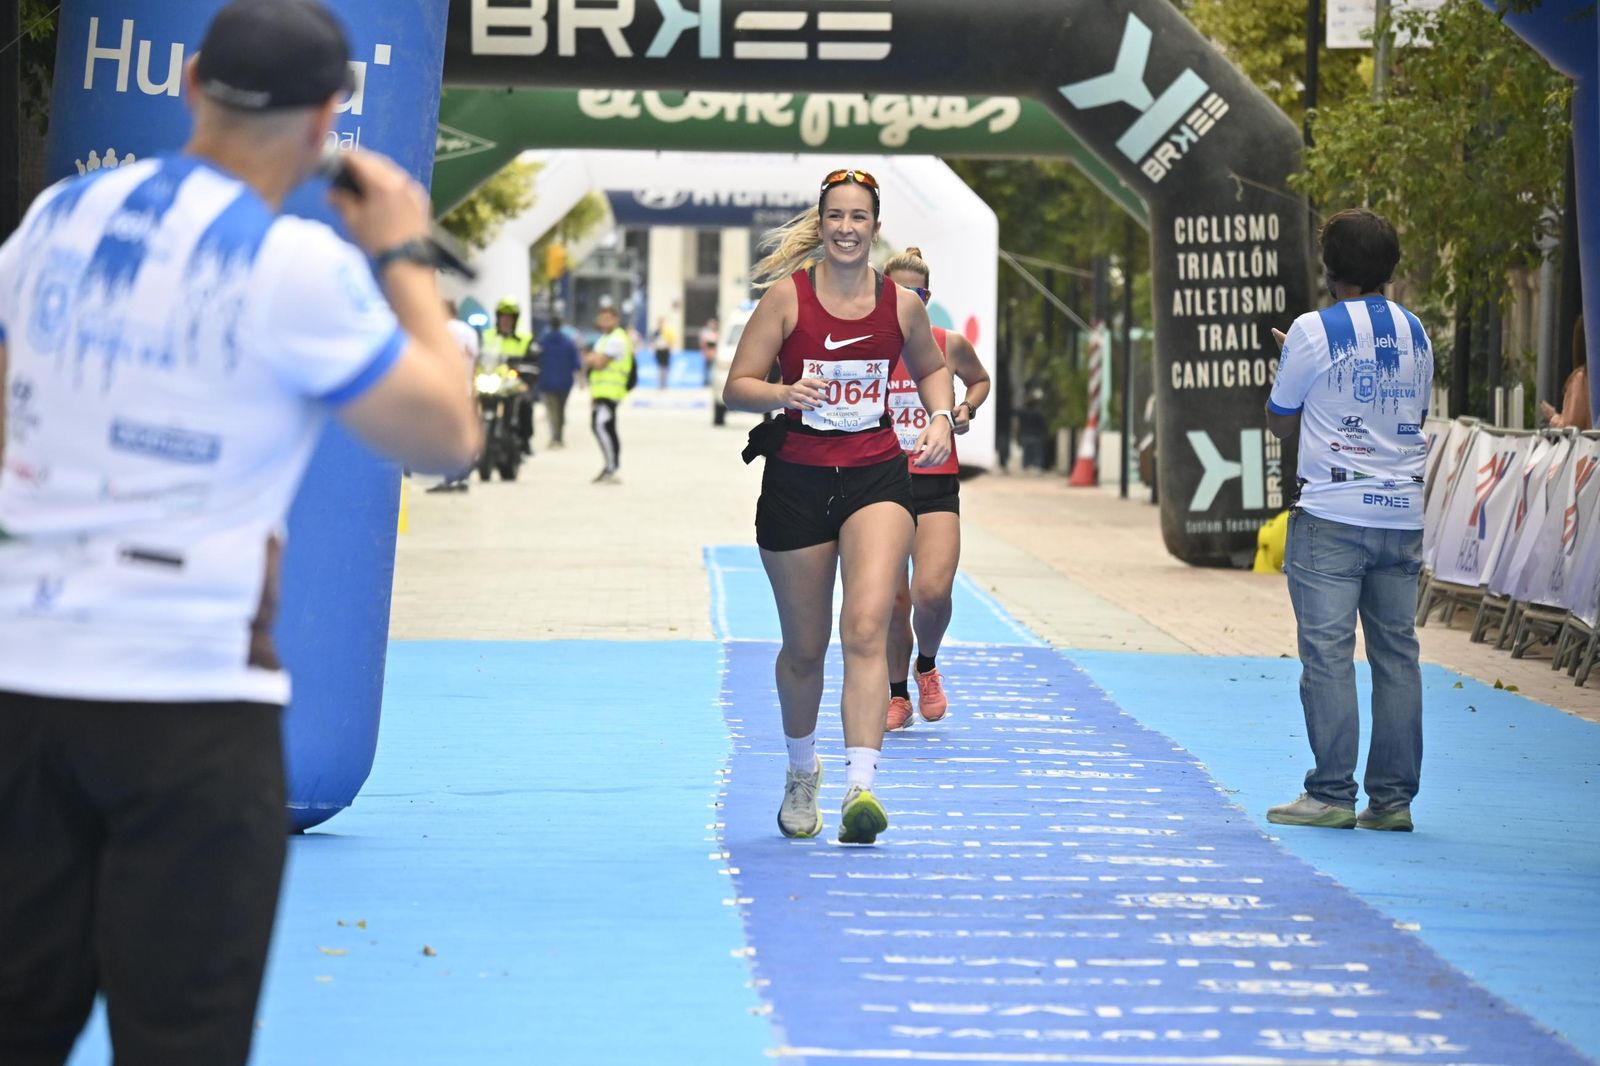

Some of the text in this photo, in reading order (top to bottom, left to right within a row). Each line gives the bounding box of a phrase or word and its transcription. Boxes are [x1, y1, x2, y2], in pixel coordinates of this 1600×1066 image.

[1174, 213, 1280, 244] CICLISMO
[1177, 245, 1278, 280] TRIATLÓN
[1172, 285, 1286, 317] ATLETISMO
[1198, 323, 1262, 352] TRAIL
[808, 363, 824, 376] 2K
[866, 362, 882, 374] 2K
[822, 380, 881, 405] 064
[1381, 388, 1416, 398] HUELVA
